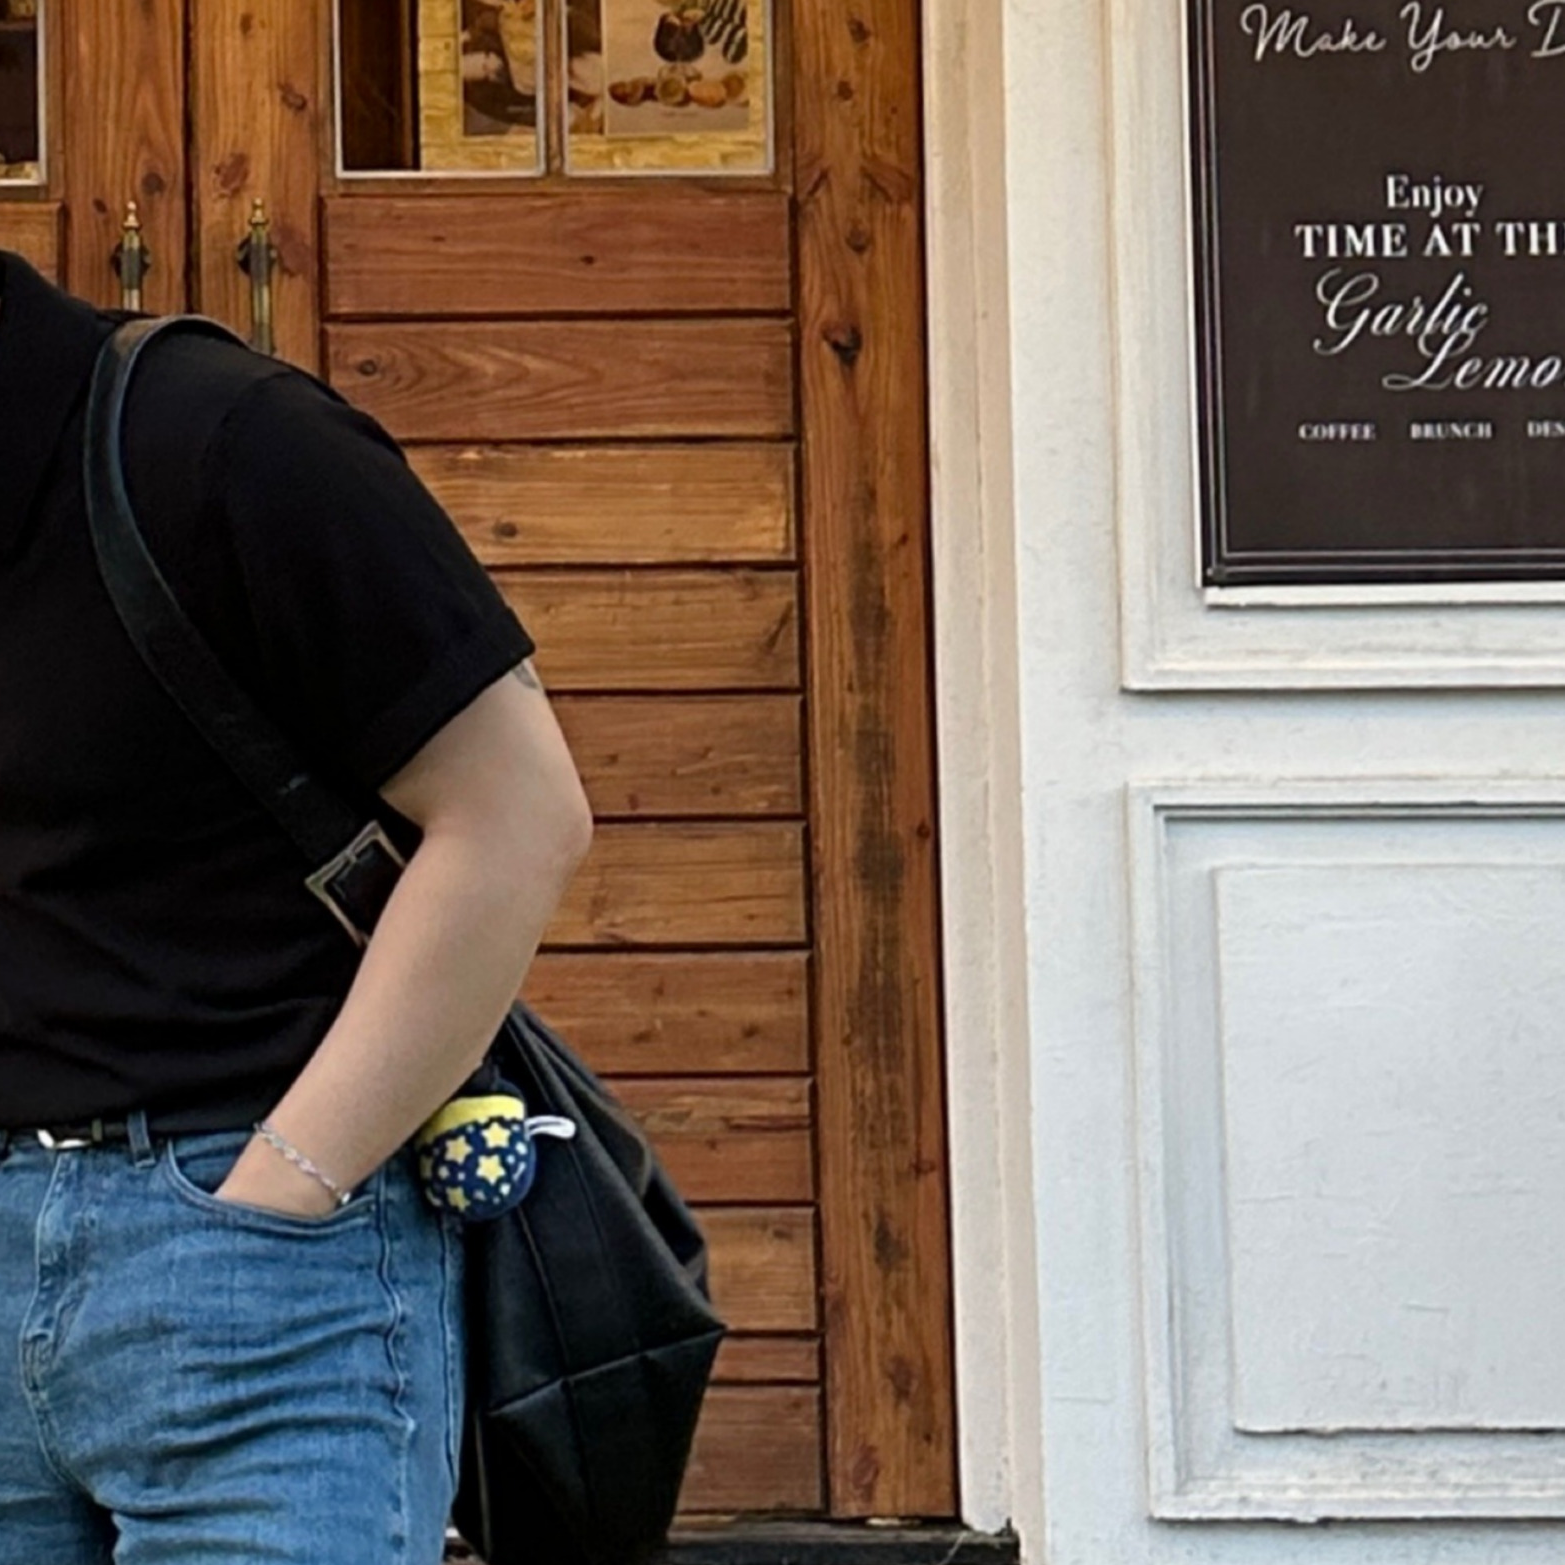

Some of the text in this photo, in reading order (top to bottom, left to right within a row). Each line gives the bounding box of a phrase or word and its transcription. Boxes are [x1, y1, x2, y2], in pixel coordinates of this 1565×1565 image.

[1240, 3, 1385, 61] Make
[1399, 1, 1516, 73] Your
[1386, 174, 1483, 217] Enjoy
[1294, 221, 1565, 258] TIME AT TH
[1313, 267, 1488, 355] Garlic
[1381, 330, 1565, 391] Lemo
[1298, 422, 1377, 440] COFFEE
[1409, 422, 1493, 439] BRUNCH
